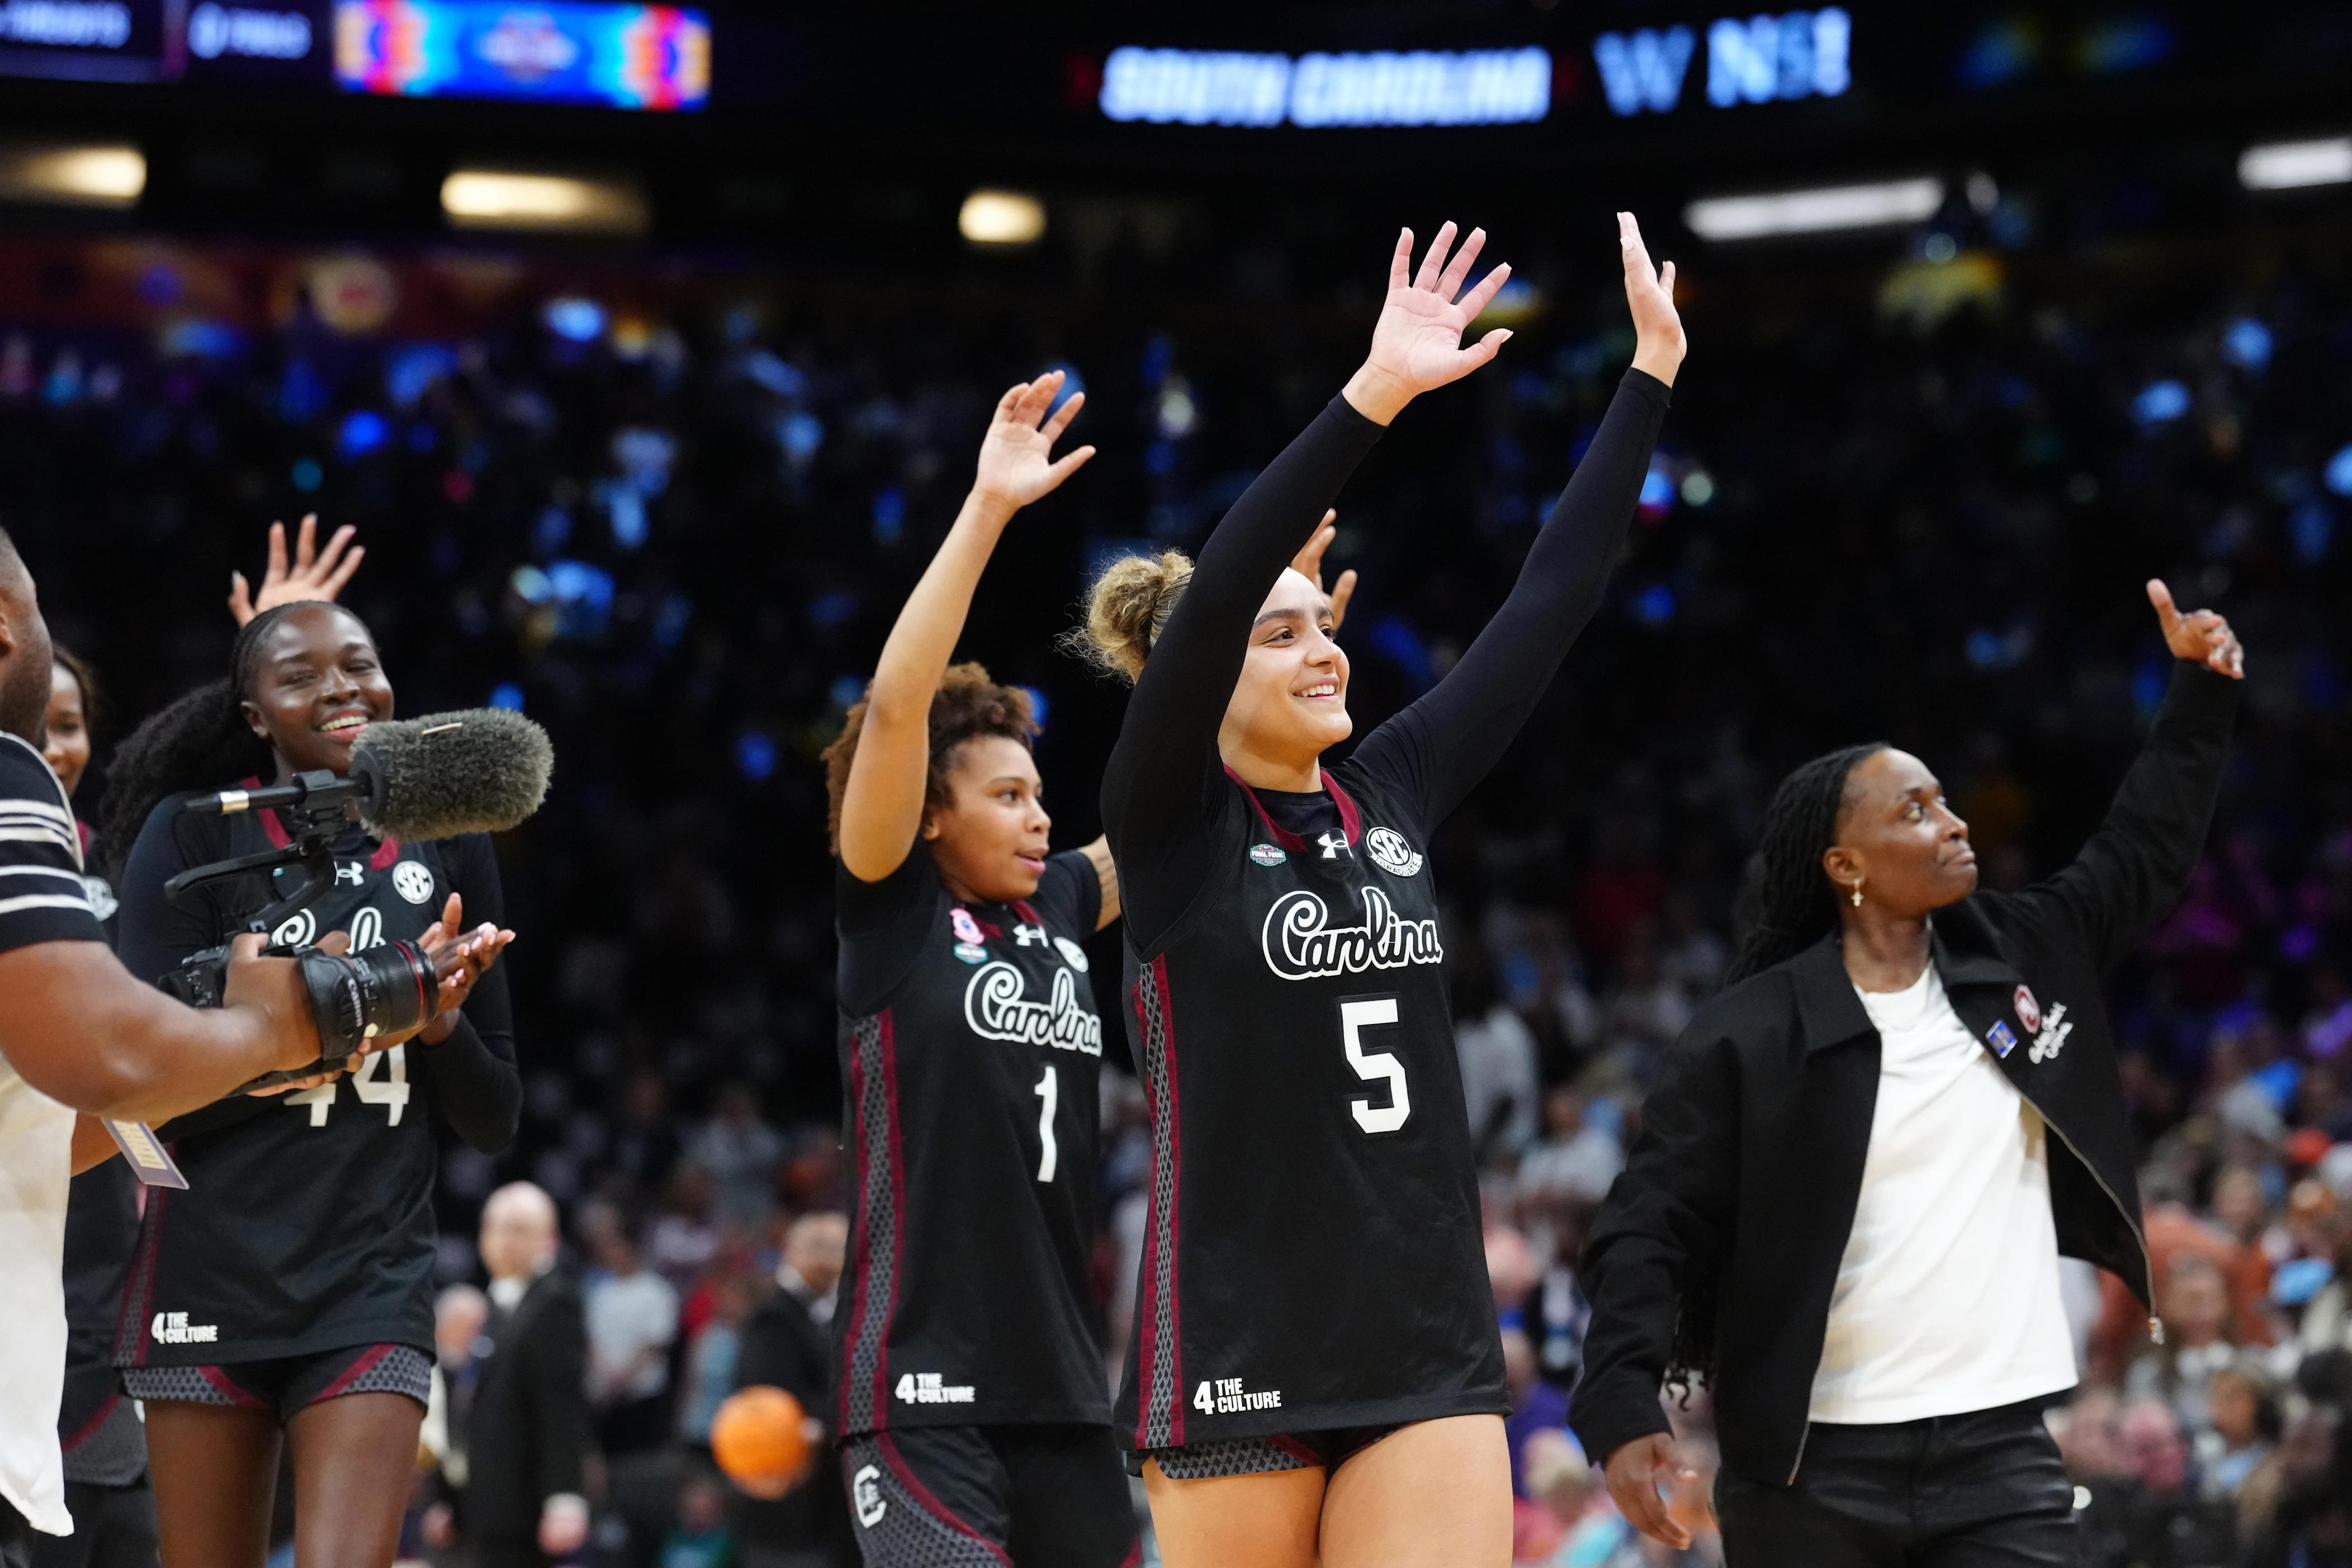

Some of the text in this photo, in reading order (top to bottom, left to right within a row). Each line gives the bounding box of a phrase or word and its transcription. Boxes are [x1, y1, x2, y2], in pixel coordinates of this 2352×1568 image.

[1370, 830, 1408, 864] SEC
[397, 865, 430, 900] SEC
[1379, 861, 1420, 875] GRADUATE
[1262, 886, 1444, 980] Carolina
[964, 961, 1102, 1057] Carolina
[1341, 999, 1410, 1134] 5
[1034, 1065, 1058, 1183] 1
[151, 1312, 189, 1344] 4 THE
[165, 1325, 218, 1343] CULTURE
[895, 1373, 943, 1404] 4 THE
[917, 1386, 976, 1403] CULTURE
[1193, 1378, 1243, 1415] 4 THE
[1217, 1391, 1282, 1413] CULTURE
